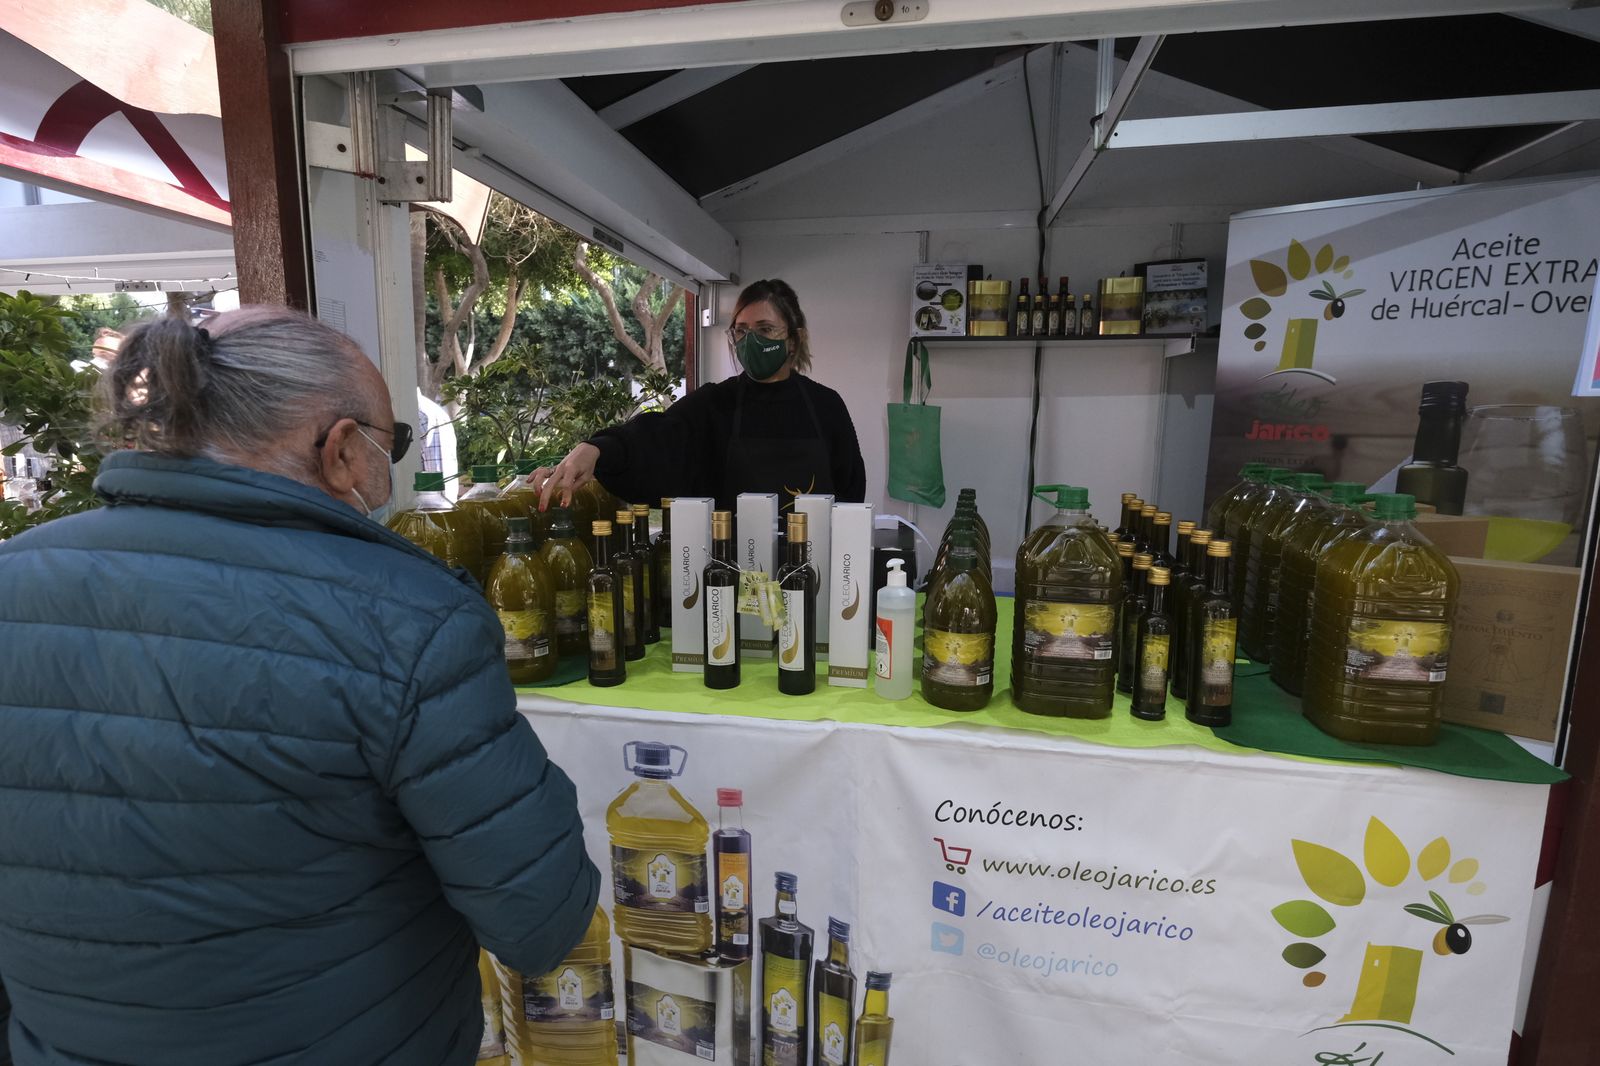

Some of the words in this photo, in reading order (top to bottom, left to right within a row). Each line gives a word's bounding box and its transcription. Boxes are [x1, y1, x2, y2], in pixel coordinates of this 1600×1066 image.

[1452, 233, 1541, 261] Aceite
[1390, 264, 1493, 292] VIRGEN
[1504, 257, 1599, 286] EXTRA
[1371, 298, 1400, 321] de
[682, 546, 690, 597] OLEOJARICO
[843, 553, 851, 607] OLEOJARICO
[711, 588, 720, 645] OLEOJARICO
[831, 668, 865, 678] PREMIUM
[934, 799, 1084, 832] Conócenos:
[982, 858, 1217, 895] www.oleojarico.es
[976, 900, 1193, 941] /aceiteoleojarico
[976, 942, 1119, 978] @oleojarico
